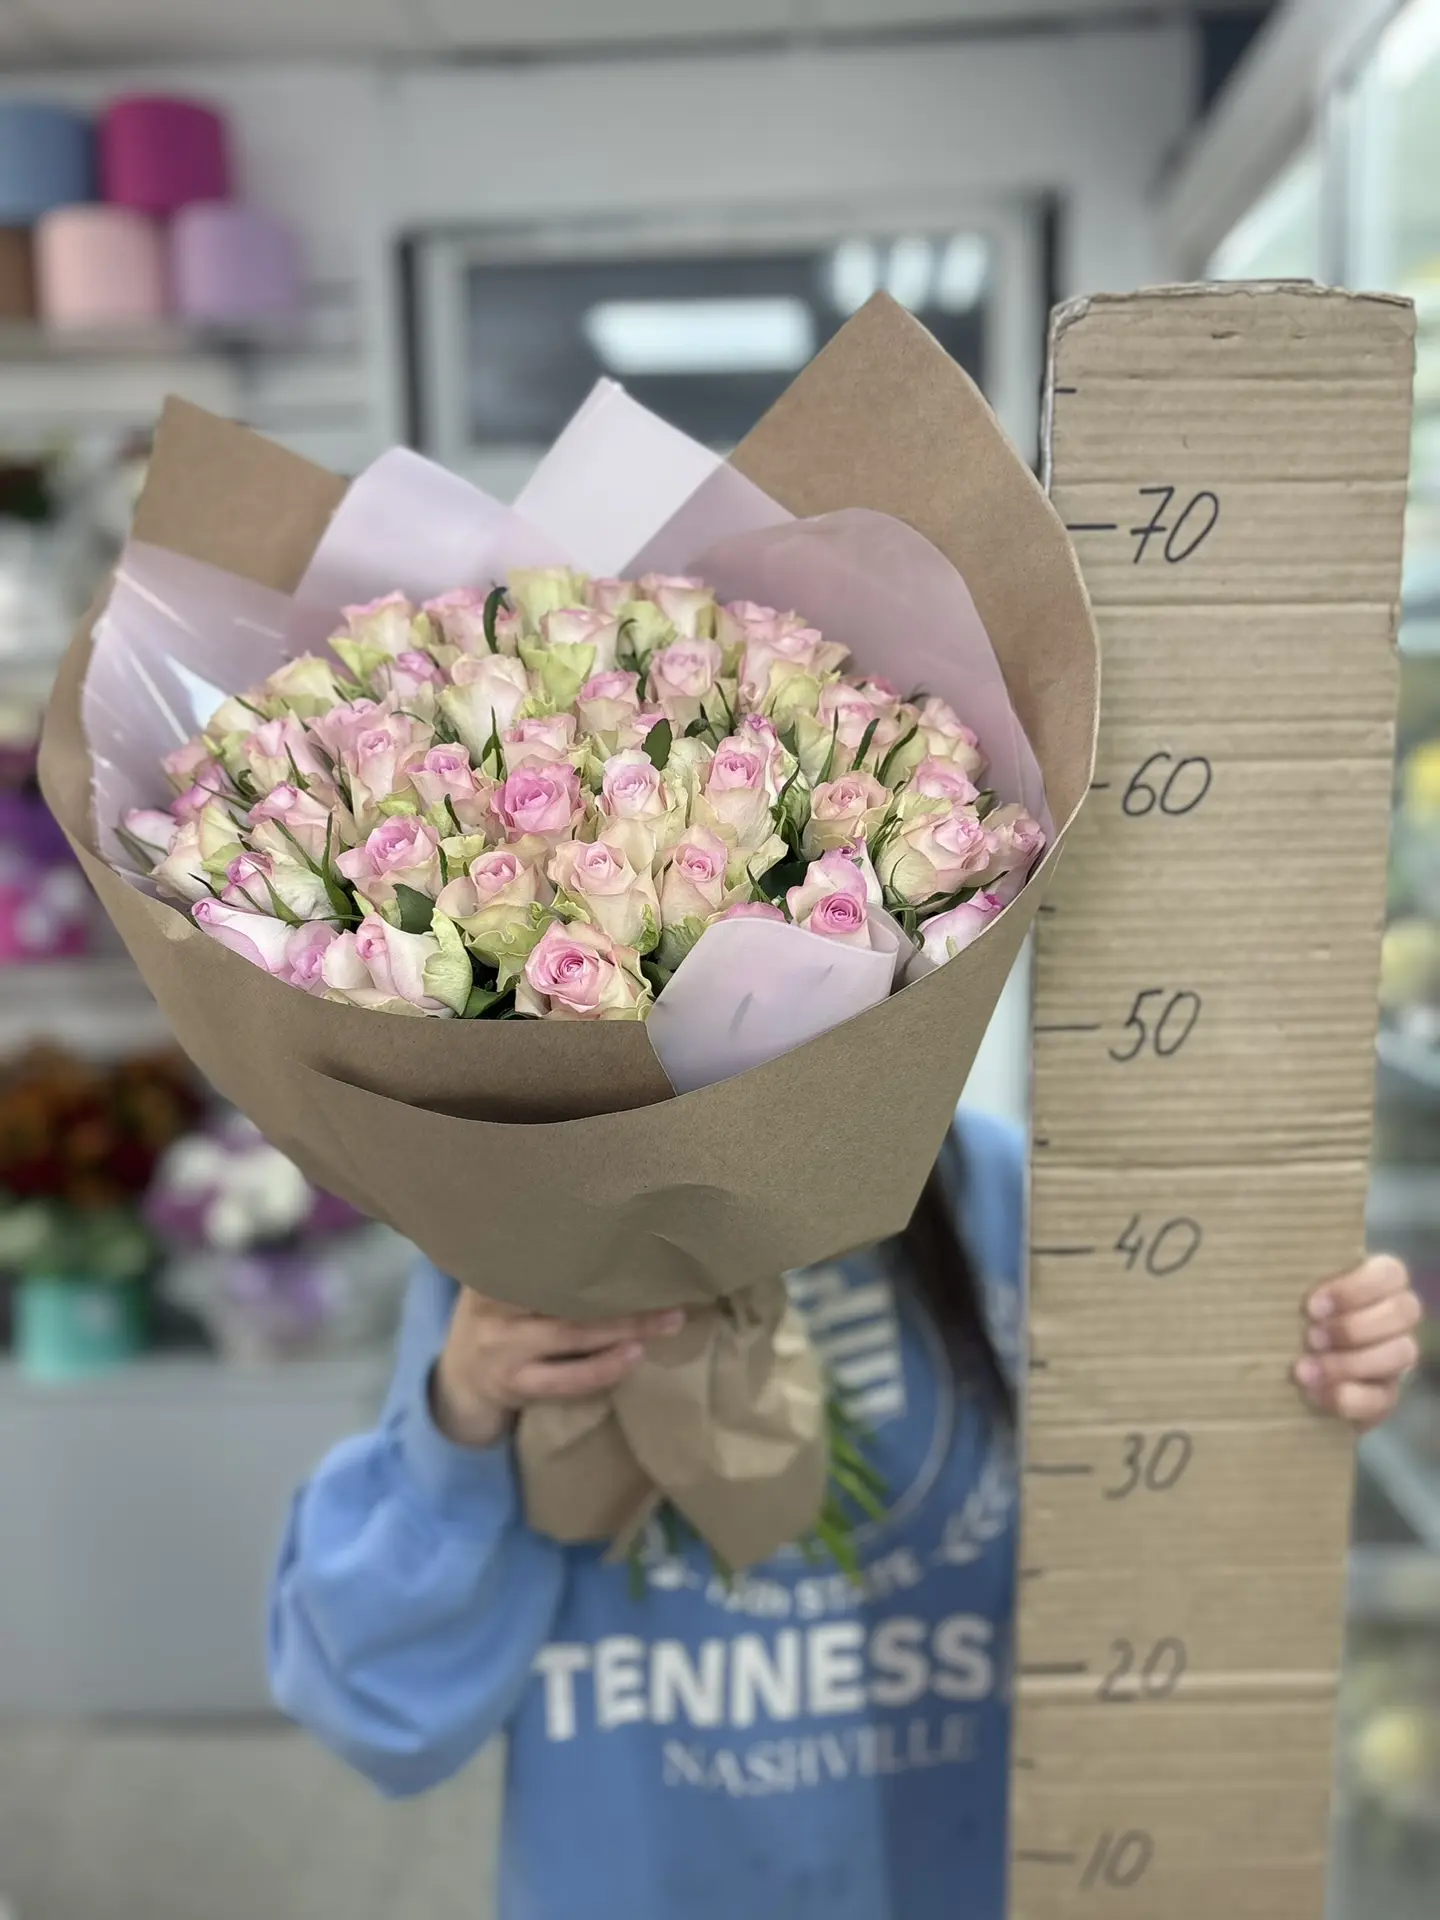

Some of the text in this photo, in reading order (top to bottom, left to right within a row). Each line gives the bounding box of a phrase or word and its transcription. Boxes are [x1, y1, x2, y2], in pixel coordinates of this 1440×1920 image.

[1130, 487, 1219, 564] 70
[1121, 752, 1212, 817] 60
[1108, 988, 1201, 1063] 50
[1112, 1214, 1200, 1277] 40
[1104, 1430, 1194, 1500] 30
[530, 1613, 1006, 1742] TENNESS
[1096, 1637, 1188, 1702] 20
[662, 1714, 982, 1797] NASHVILLE
[1078, 1829, 1156, 1892] 10
